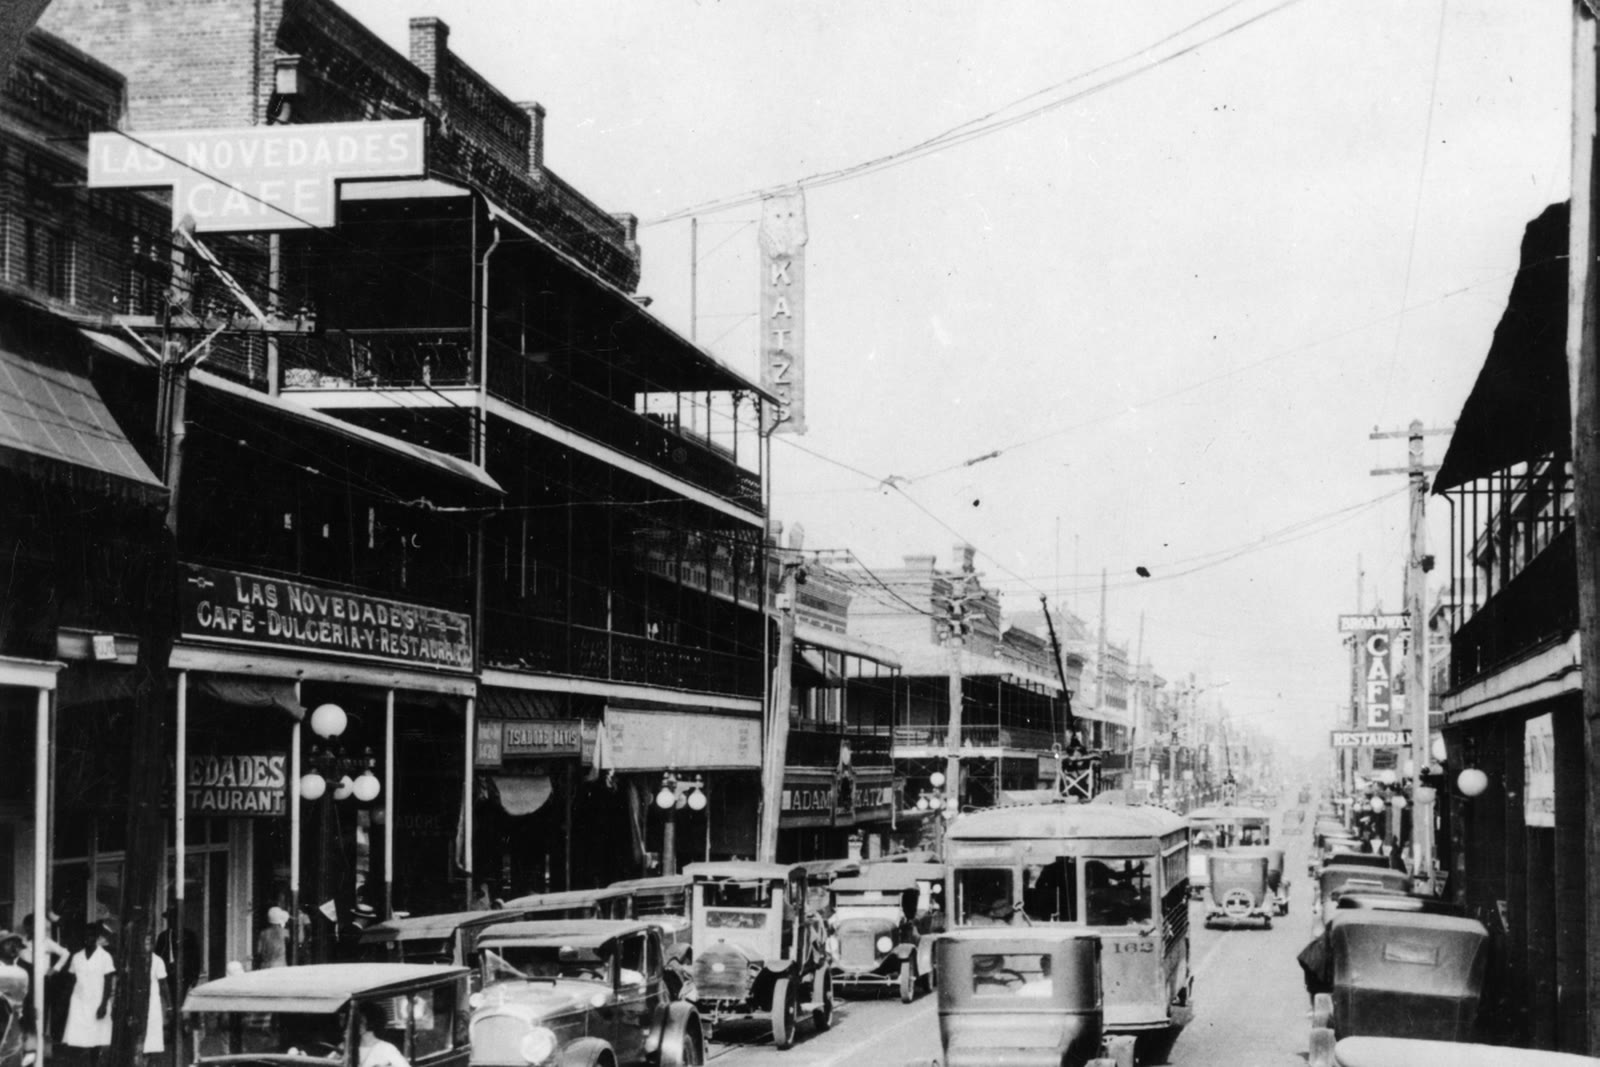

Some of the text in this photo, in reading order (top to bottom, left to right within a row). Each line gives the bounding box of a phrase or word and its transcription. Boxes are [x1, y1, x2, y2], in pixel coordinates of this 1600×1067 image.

[101, 132, 410, 173] LAS NOVEDADES
[187, 177, 321, 218] CAFE
[235, 576, 415, 630] LAS NOVEDADES
[1367, 634, 1389, 727] CAFE
[1113, 943, 1154, 954] 162
